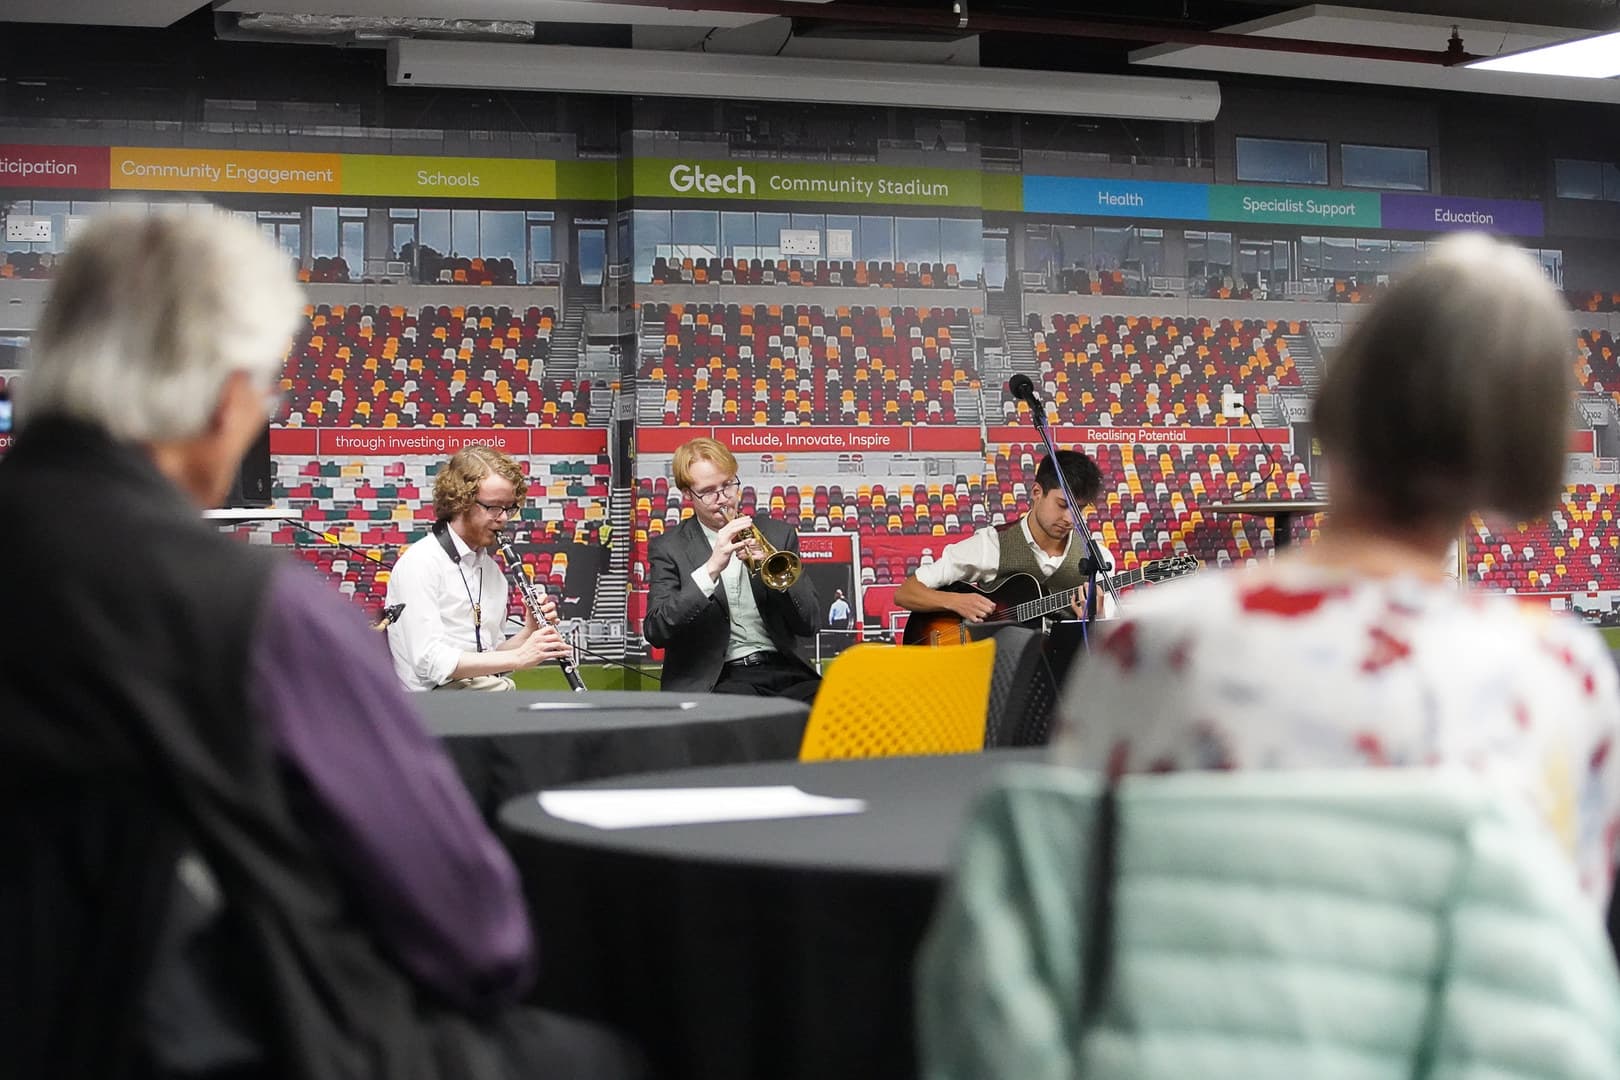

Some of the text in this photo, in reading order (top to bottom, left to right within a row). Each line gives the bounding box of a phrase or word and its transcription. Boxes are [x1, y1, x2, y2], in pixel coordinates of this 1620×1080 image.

[120, 159, 334, 184] Community Engagement
[416, 170, 480, 187] Schools
[669, 164, 949, 197] Gtech Community Stadium
[1097, 191, 1144, 207] Health
[1242, 196, 1356, 217] Specialist Support
[1434, 208, 1494, 225] Education
[335, 435, 506, 451] through investing in people
[731, 433, 891, 448] Include, Innovate, Inspire
[1087, 429, 1187, 443] Realising Potential
